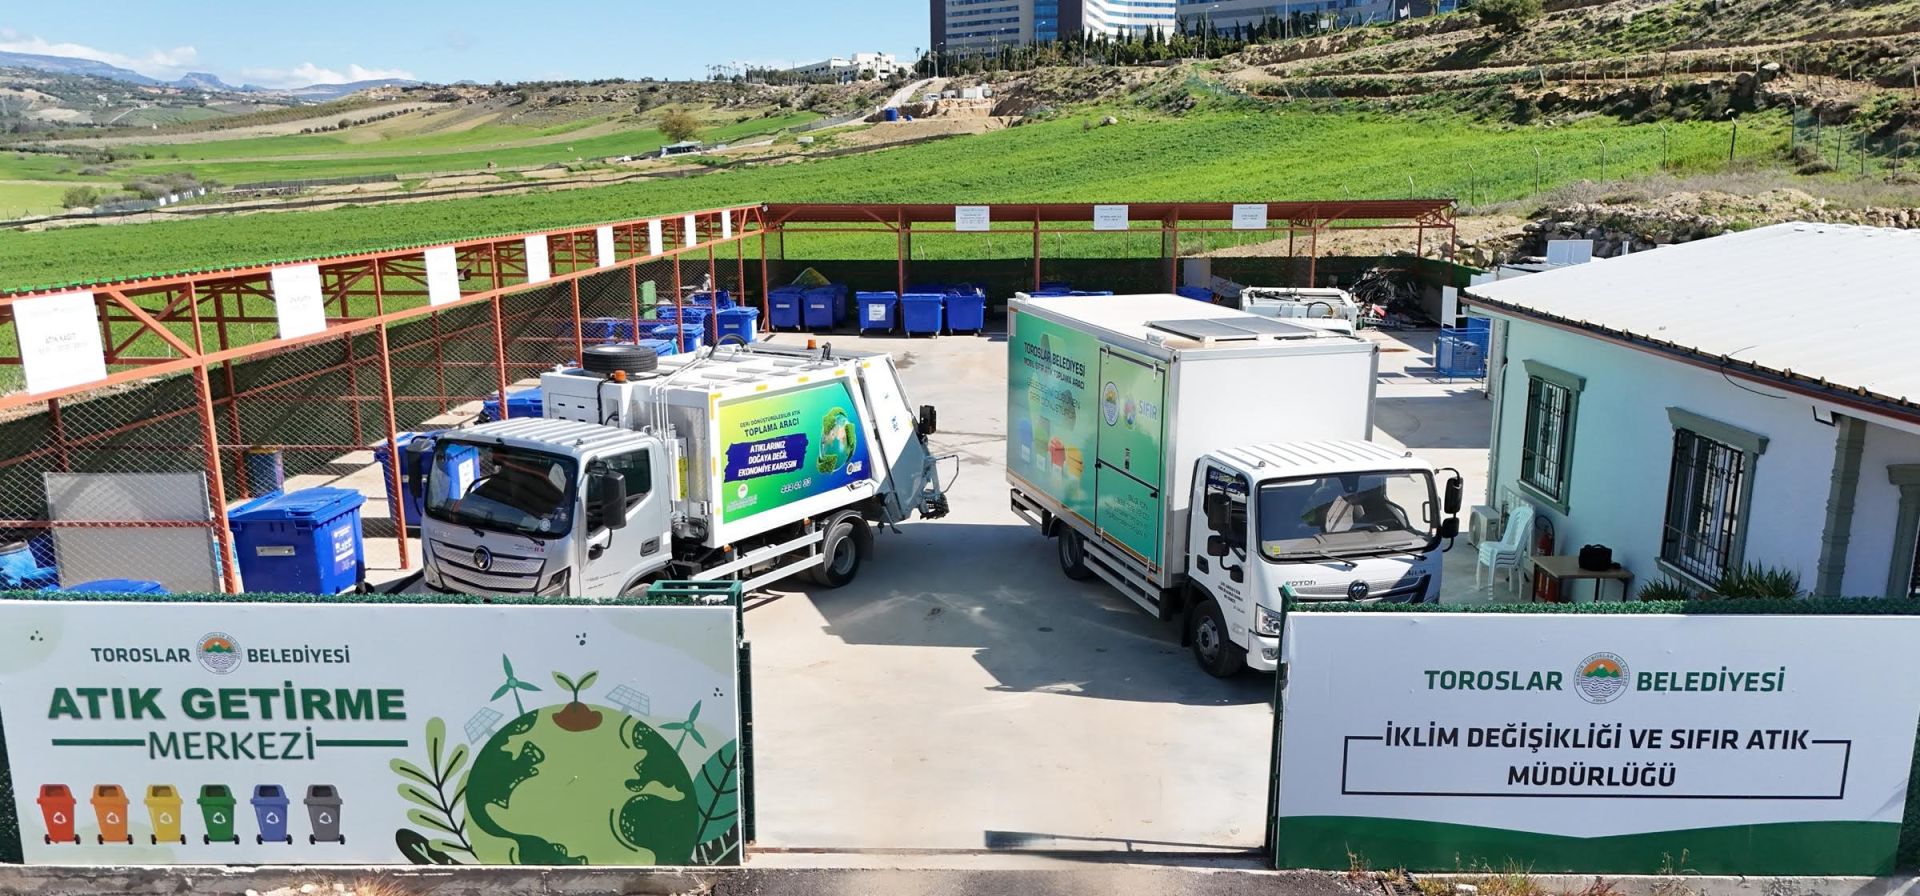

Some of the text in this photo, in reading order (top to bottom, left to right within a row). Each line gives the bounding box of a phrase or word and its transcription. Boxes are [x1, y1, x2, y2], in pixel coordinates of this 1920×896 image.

[1023, 341, 1085, 377] TOROSLAR BELEDİYESİ
[1138, 400, 1158, 420] SIFIR
[744, 417, 800, 437] TOPLAMA ARACI
[750, 440, 786, 453] ATIKLARINIZ
[748, 453, 772, 464] DOĞAYA
[738, 463, 771, 477] EKONOMİYE
[91, 647, 192, 662] TOROSLAR
[248, 645, 350, 663] BELEDİYESİ
[1424, 666, 1786, 692] TOROSLAR BELEDİYESİ
[47, 680, 407, 721] ATIK GETİRME
[149, 727, 315, 761] MERKEZİ
[1386, 721, 1809, 754] İKLİM DEĞİŞİKLİĞİ VE SIFIR ATIK
[1508, 762, 1677, 787] MÜDÜRLÜĞÜ
